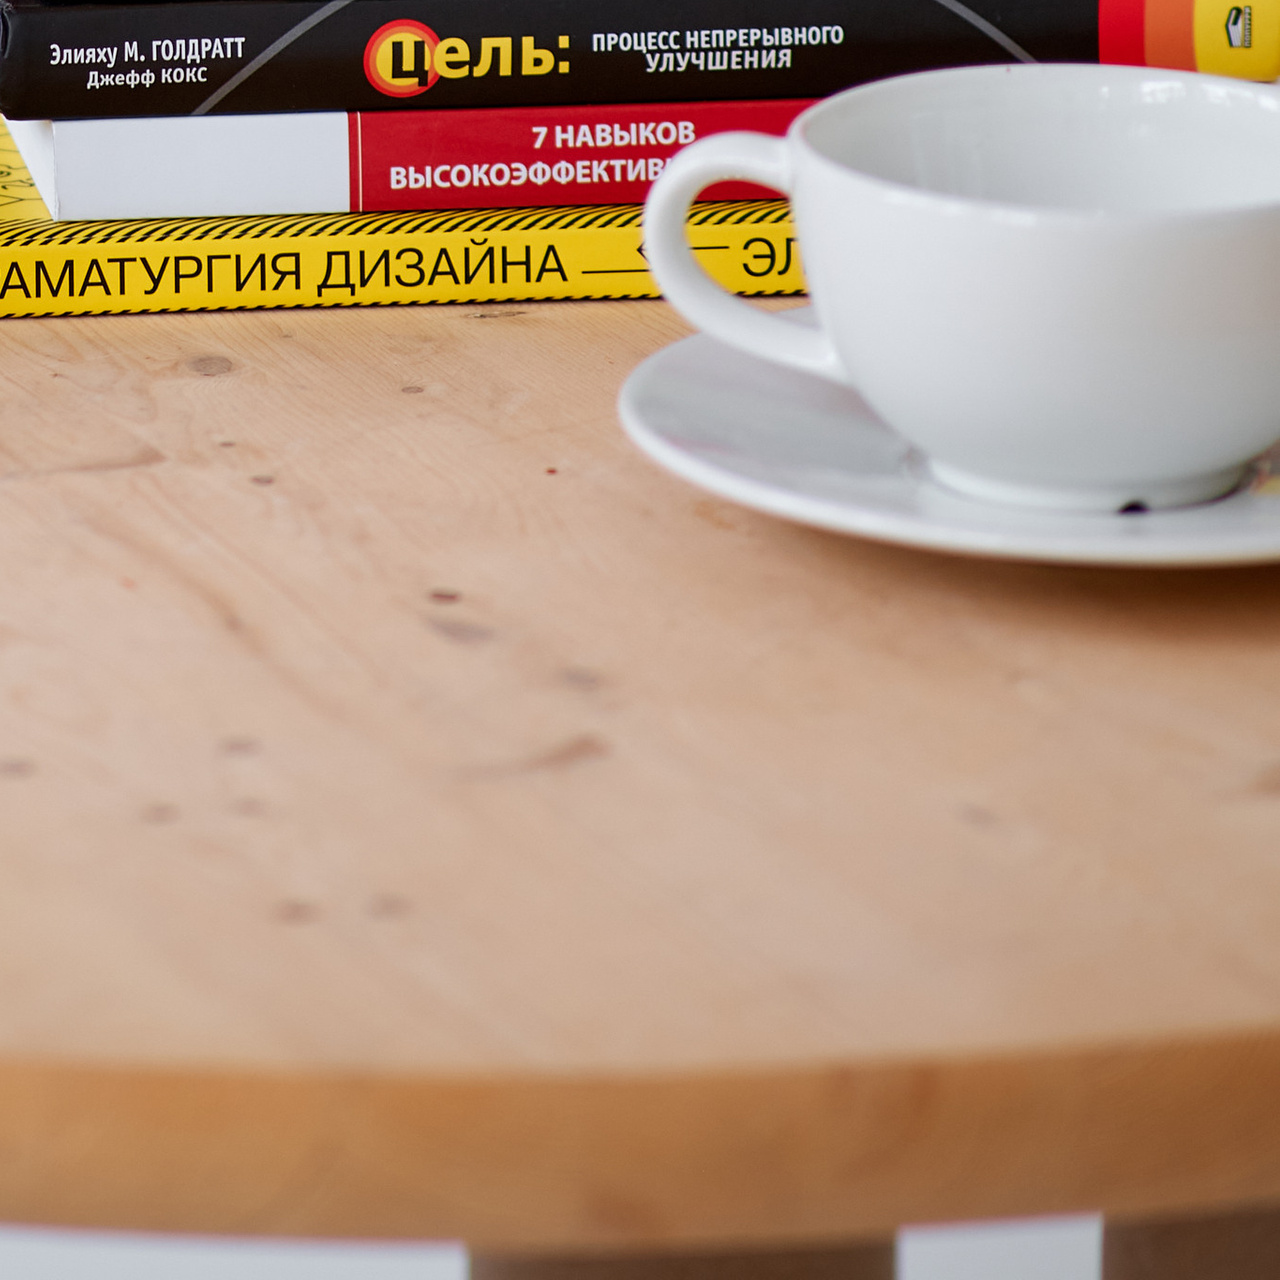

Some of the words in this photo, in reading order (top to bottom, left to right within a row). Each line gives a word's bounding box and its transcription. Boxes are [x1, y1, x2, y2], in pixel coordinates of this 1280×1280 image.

[50, 43, 118, 68] Элияху
[124, 41, 146, 62] М.
[152, 37, 246, 64] ГОЛДРАТТ
[592, 30, 681, 53] ПРОЦЕСС
[685, 25, 845, 49] НЕПРЕРЫВНОГО
[645, 48, 793, 73] УЛУЧШЕНИЯ
[86, 68, 156, 90] Джефф
[161, 66, 208, 84] КОКС
[531, 126, 549, 149] 7
[554, 121, 696, 148] НАВЫКОВ
[389, 157, 672, 190] ВЫСОКОЭФФЕКТИВ
[317, 238, 569, 297] ДИЗАЙНА
